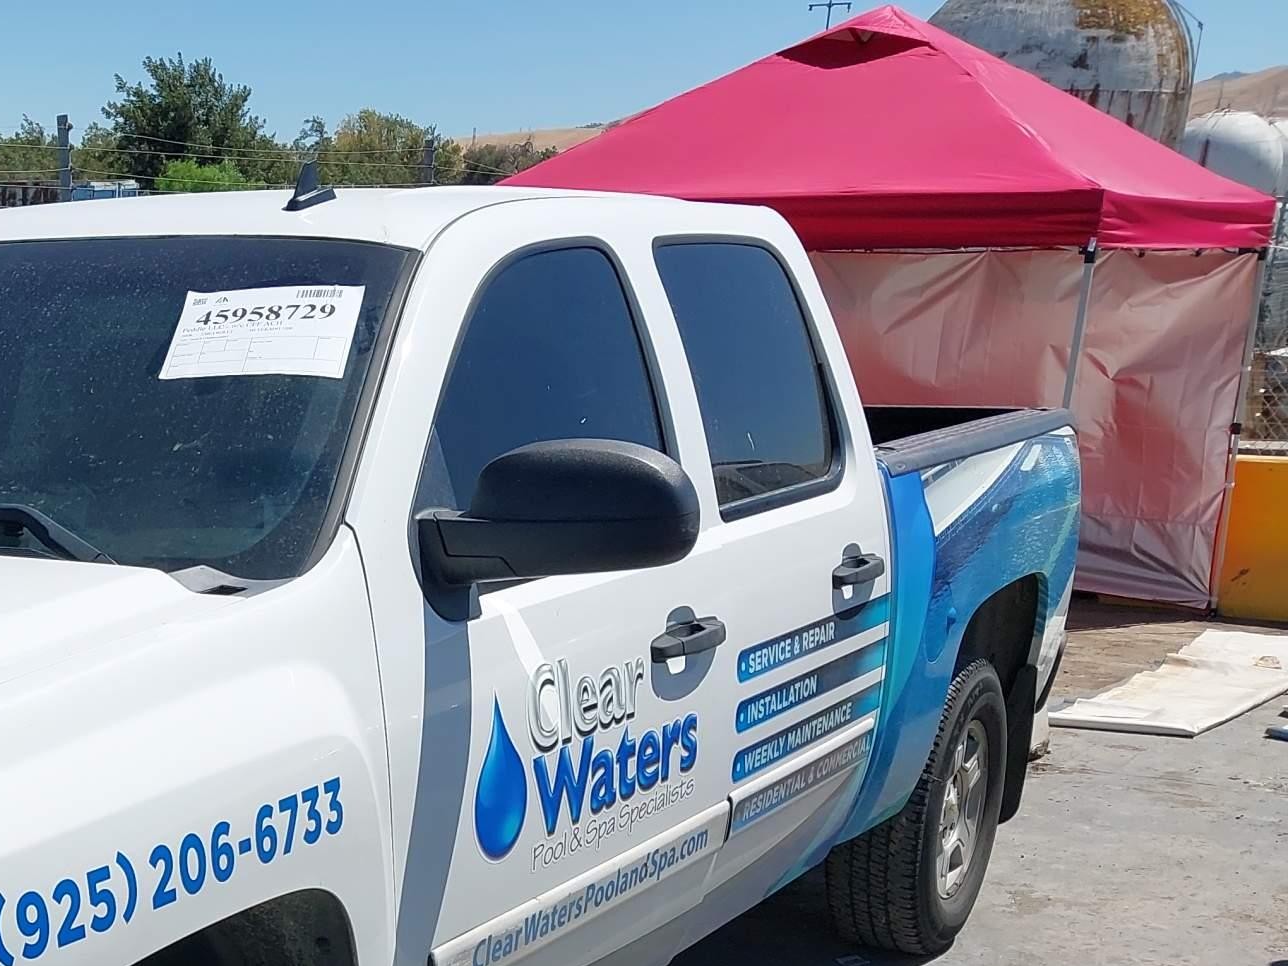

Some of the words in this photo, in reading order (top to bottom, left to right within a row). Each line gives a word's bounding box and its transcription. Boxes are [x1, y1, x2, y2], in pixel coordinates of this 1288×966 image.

[195, 302, 336, 325] 45958729
[748, 638, 792, 674] SERVICE
[793, 636, 801, 655] &
[802, 622, 836, 651] REPAIR
[528, 657, 645, 753] Clear
[743, 735, 786, 774] WEEKLY
[786, 702, 852, 751] MAINTENANCE
[747, 674, 818, 724] INSTALLATION
[532, 712, 698, 837] Waters
[742, 773, 806, 821] RESIDENTIAL
[808, 766, 815, 784] &
[816, 734, 871, 778] COMMERCIAL
[148, 776, 345, 911] 206-6733
[532, 843, 567, 871] Pool
[570, 827, 583, 853] &
[586, 816, 616, 850] Spa
[619, 778, 694, 833] Specialists
